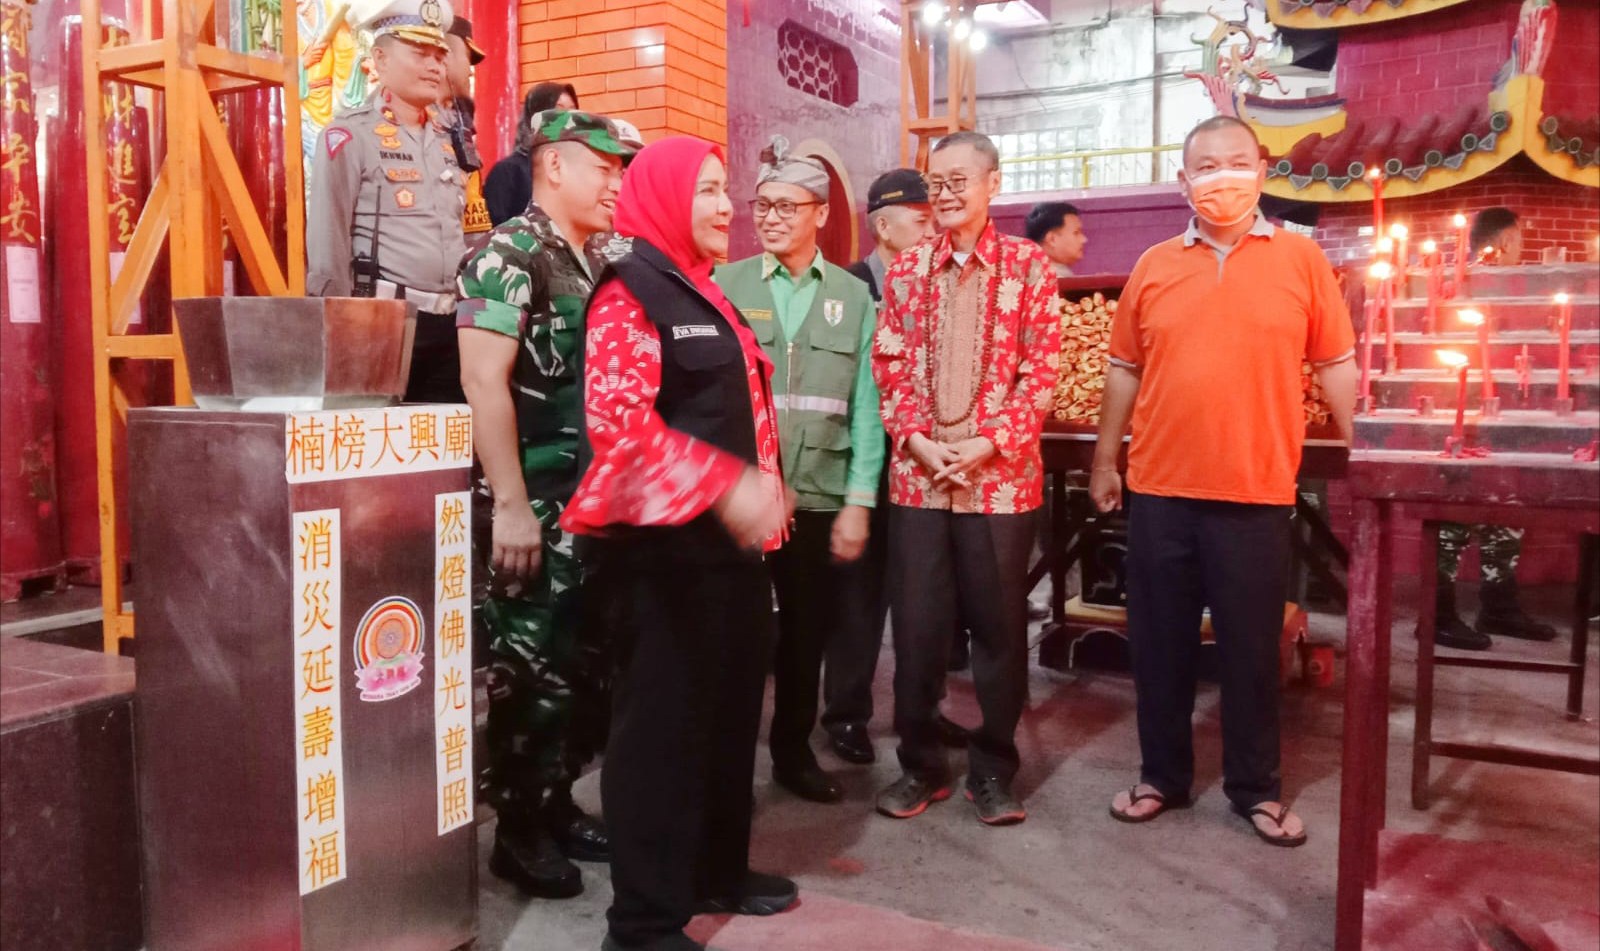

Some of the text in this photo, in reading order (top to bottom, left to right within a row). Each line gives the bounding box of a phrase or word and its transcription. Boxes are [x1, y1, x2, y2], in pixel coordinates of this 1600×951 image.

[287, 410, 472, 475] 楠榜大興廟
[299, 516, 338, 889] 消災延壽增福
[438, 497, 468, 828] 然燈佛光普照
